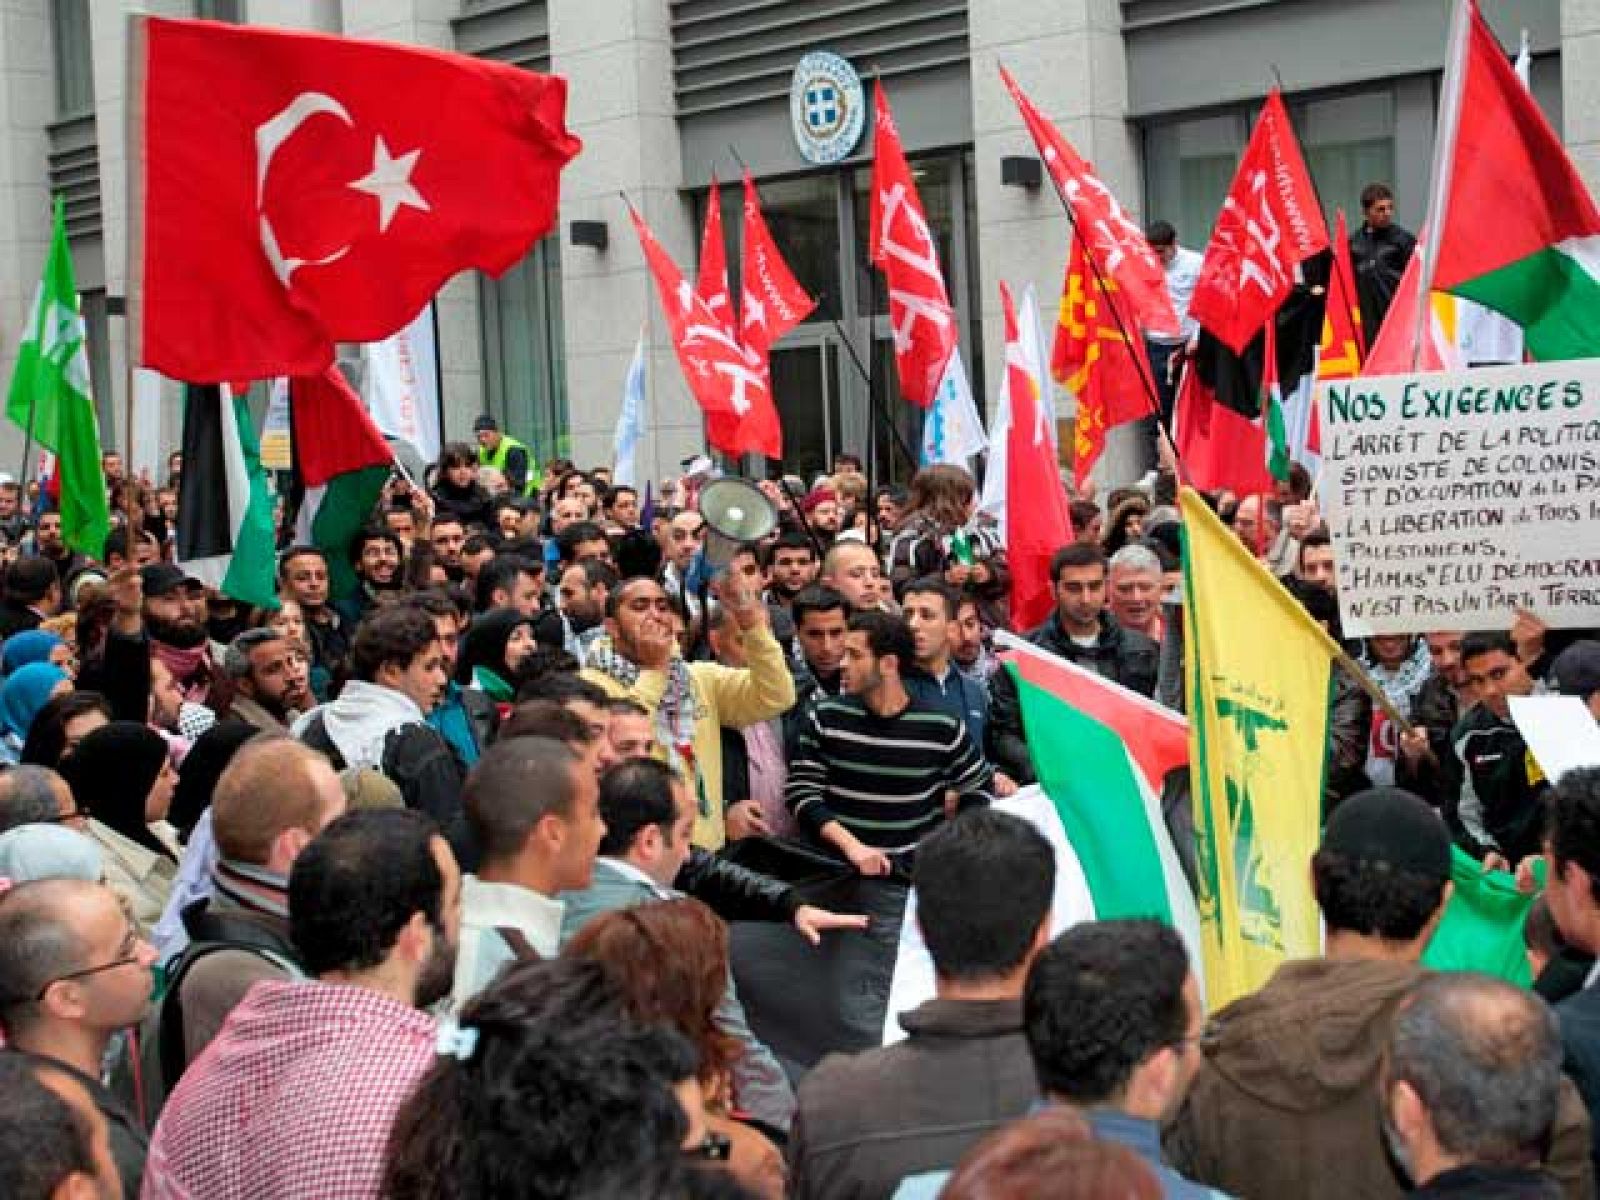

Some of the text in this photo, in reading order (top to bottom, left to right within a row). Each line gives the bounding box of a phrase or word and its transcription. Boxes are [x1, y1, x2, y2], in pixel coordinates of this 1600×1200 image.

[1328, 380, 1583, 425] NOS EXIGENCES
[1437, 429, 1469, 455] DE
[1480, 428, 1512, 451] LA
[1341, 459, 1451, 486] SIONISTE
[1462, 456, 1489, 477] DE
[1343, 486, 1378, 506] ET
